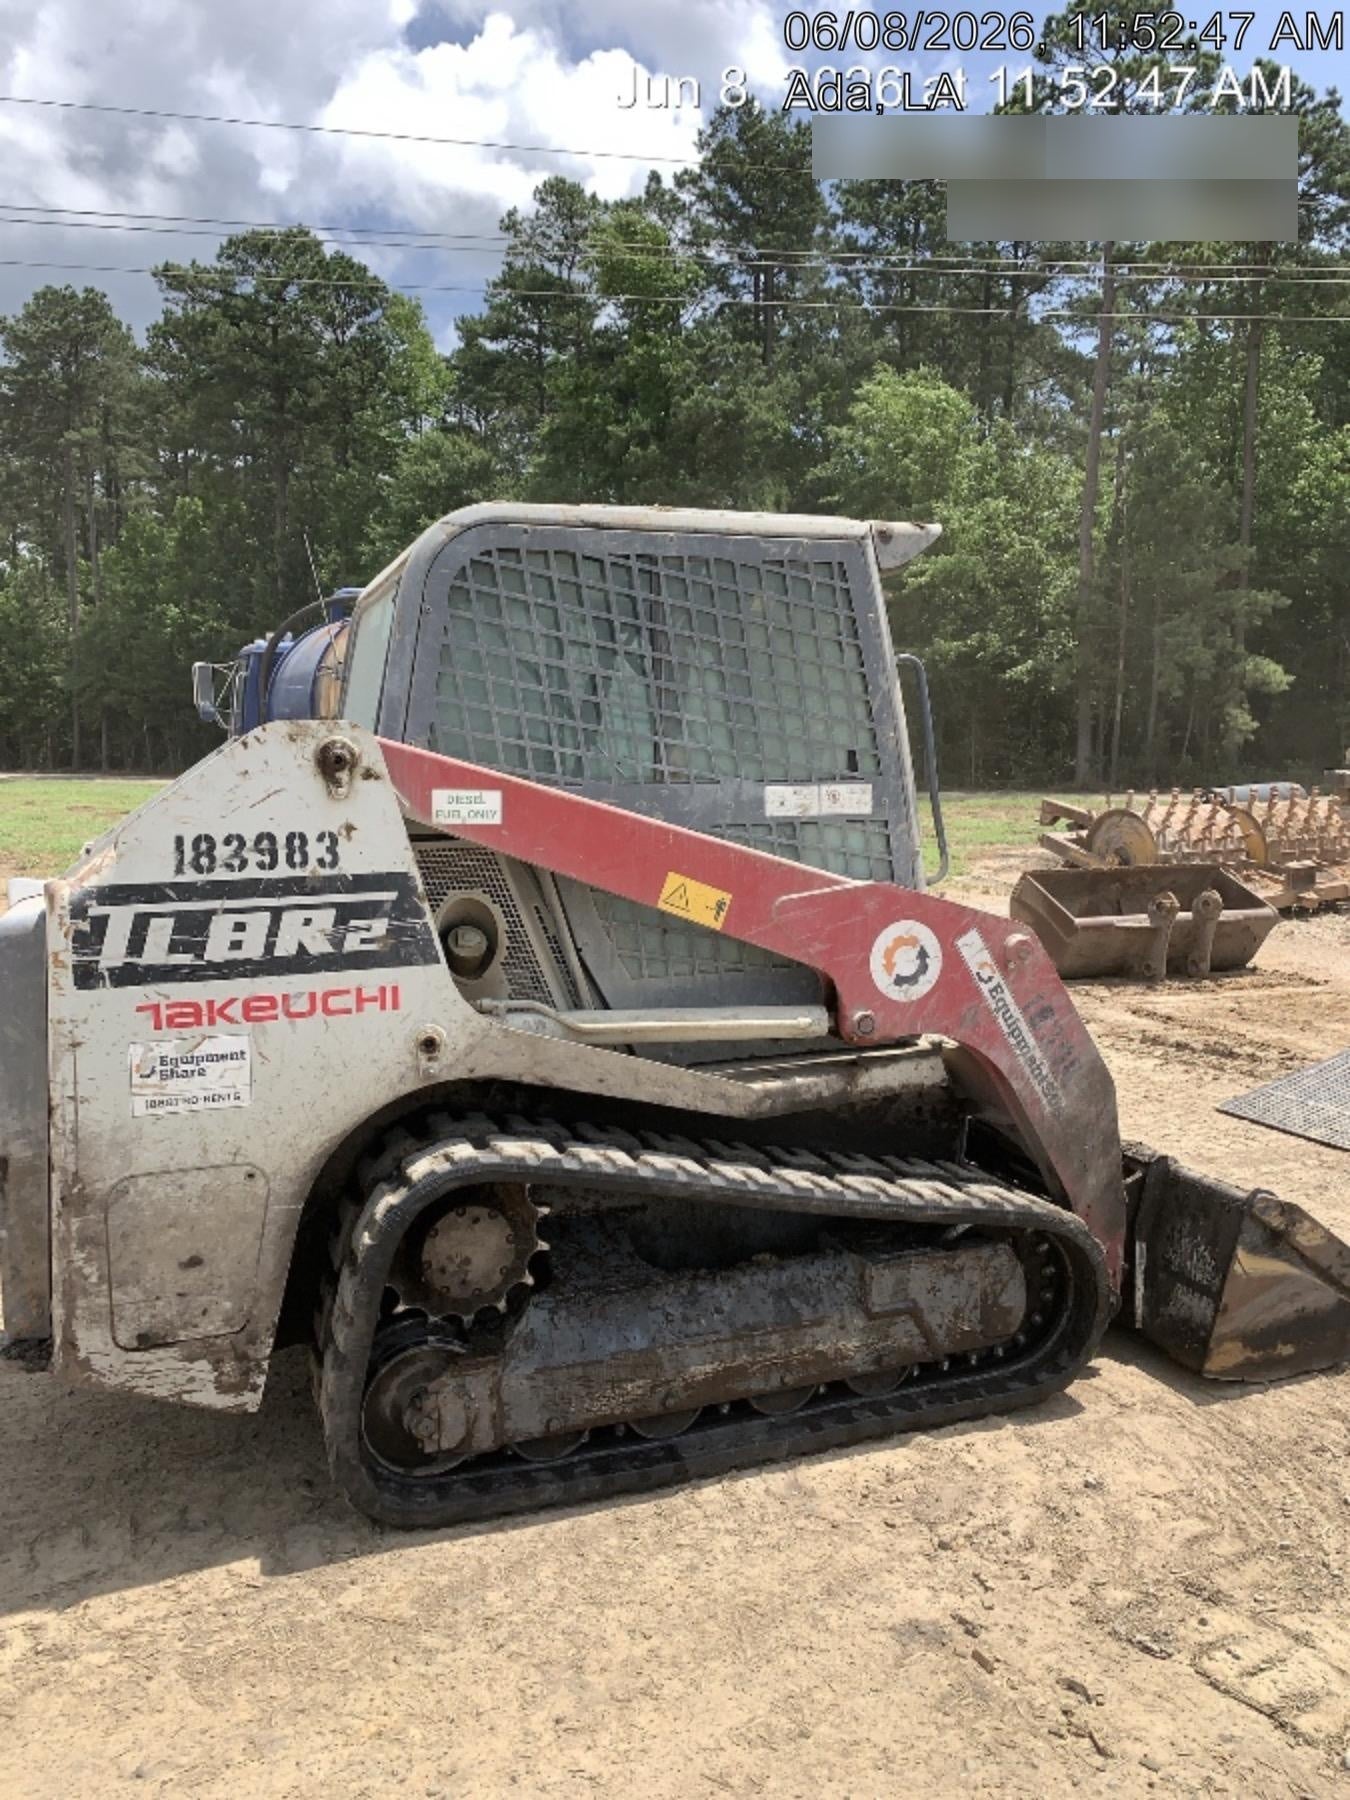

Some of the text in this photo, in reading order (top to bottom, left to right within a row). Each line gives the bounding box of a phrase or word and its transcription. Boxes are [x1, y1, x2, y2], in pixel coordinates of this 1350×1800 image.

[447, 792, 487, 805] DIESEL
[467, 809, 498, 820] ONLY
[173, 830, 340, 877] 183983
[159, 1050, 247, 1068] Equipment
[159, 1067, 207, 1081] Share
